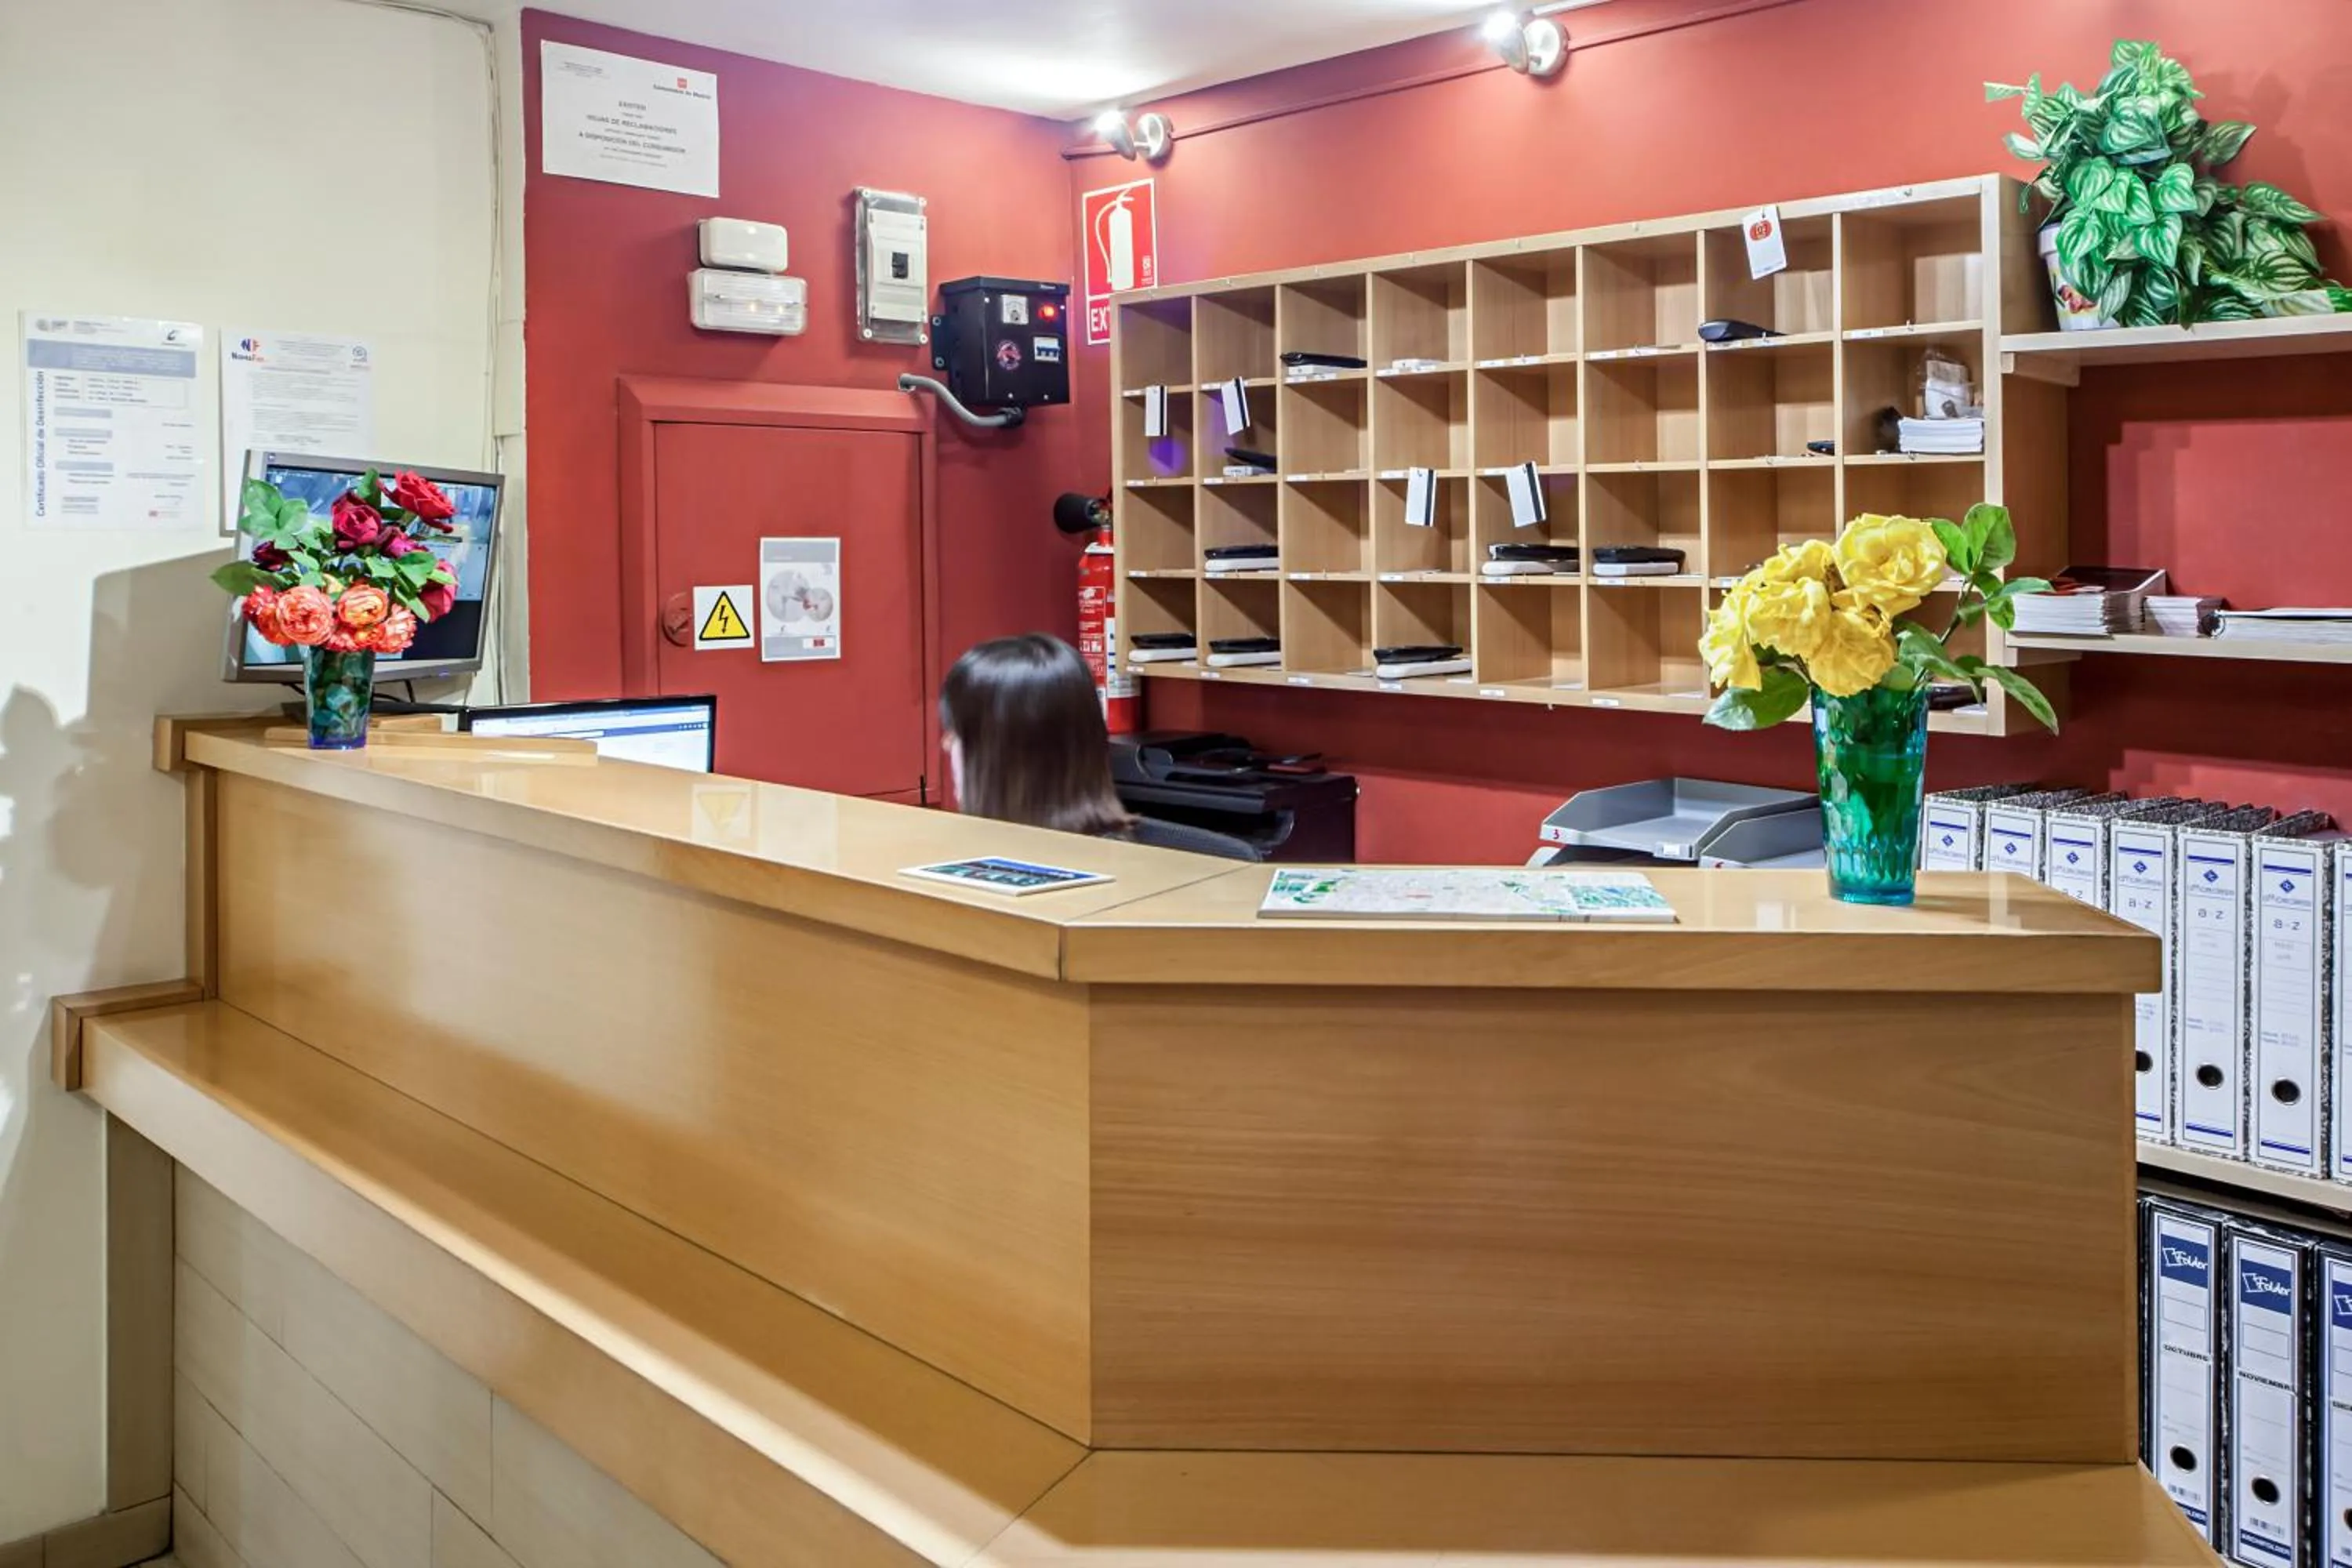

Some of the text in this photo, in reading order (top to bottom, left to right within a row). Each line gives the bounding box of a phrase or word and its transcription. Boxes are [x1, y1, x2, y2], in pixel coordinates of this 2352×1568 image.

[37, 429, 45, 439] de
[35, 440, 45, 468] Oficial
[2163, 1344, 2209, 1363] OCTUBRE
